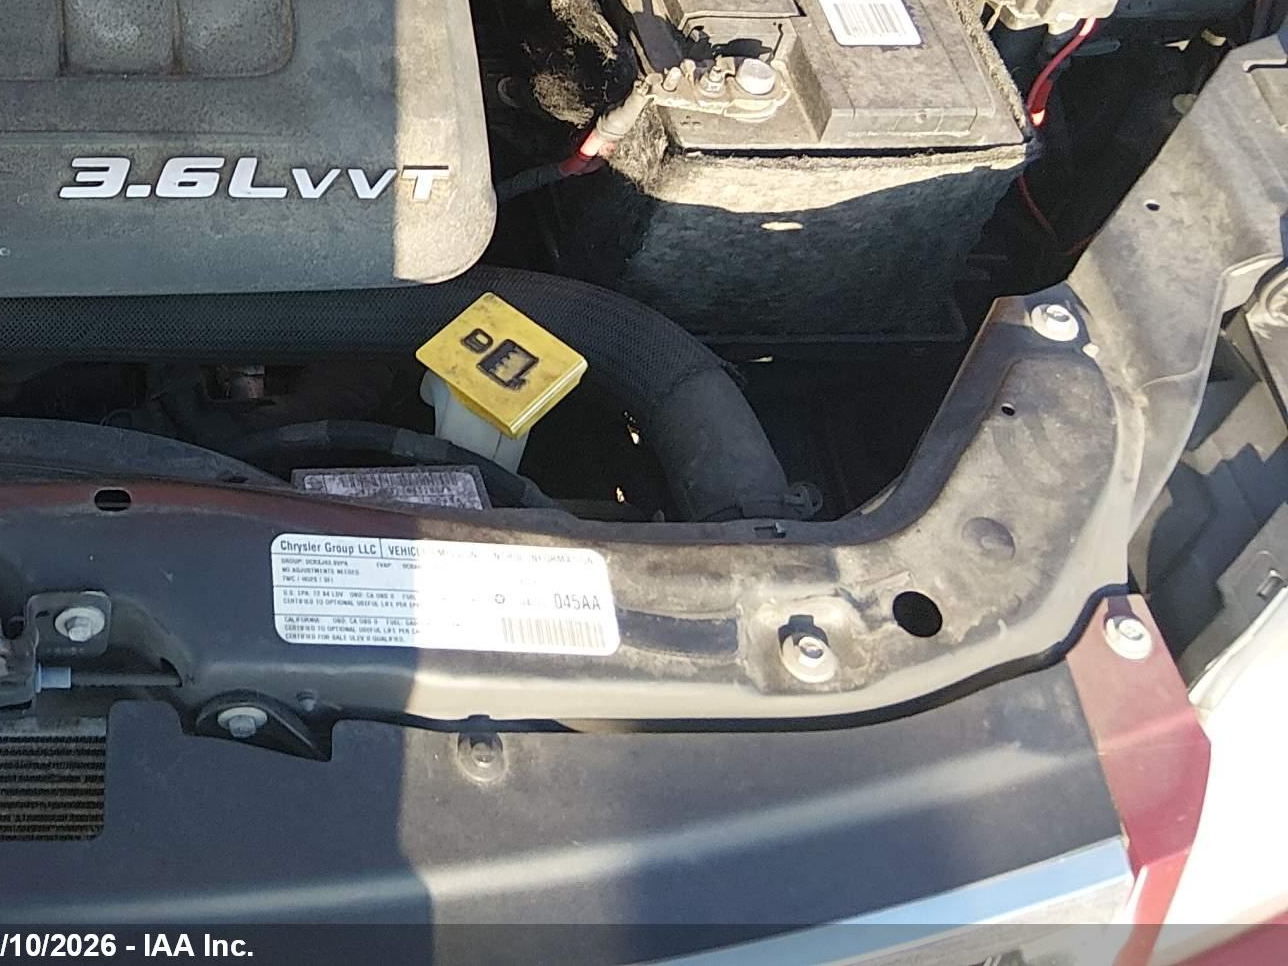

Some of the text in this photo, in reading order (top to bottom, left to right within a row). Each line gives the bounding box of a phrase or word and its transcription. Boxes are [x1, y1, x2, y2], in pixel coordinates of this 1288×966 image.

[280, 540, 377, 556] Chrysler Group LLC
[388, 545, 425, 557] VEHICL
[554, 593, 603, 611] 045AA
